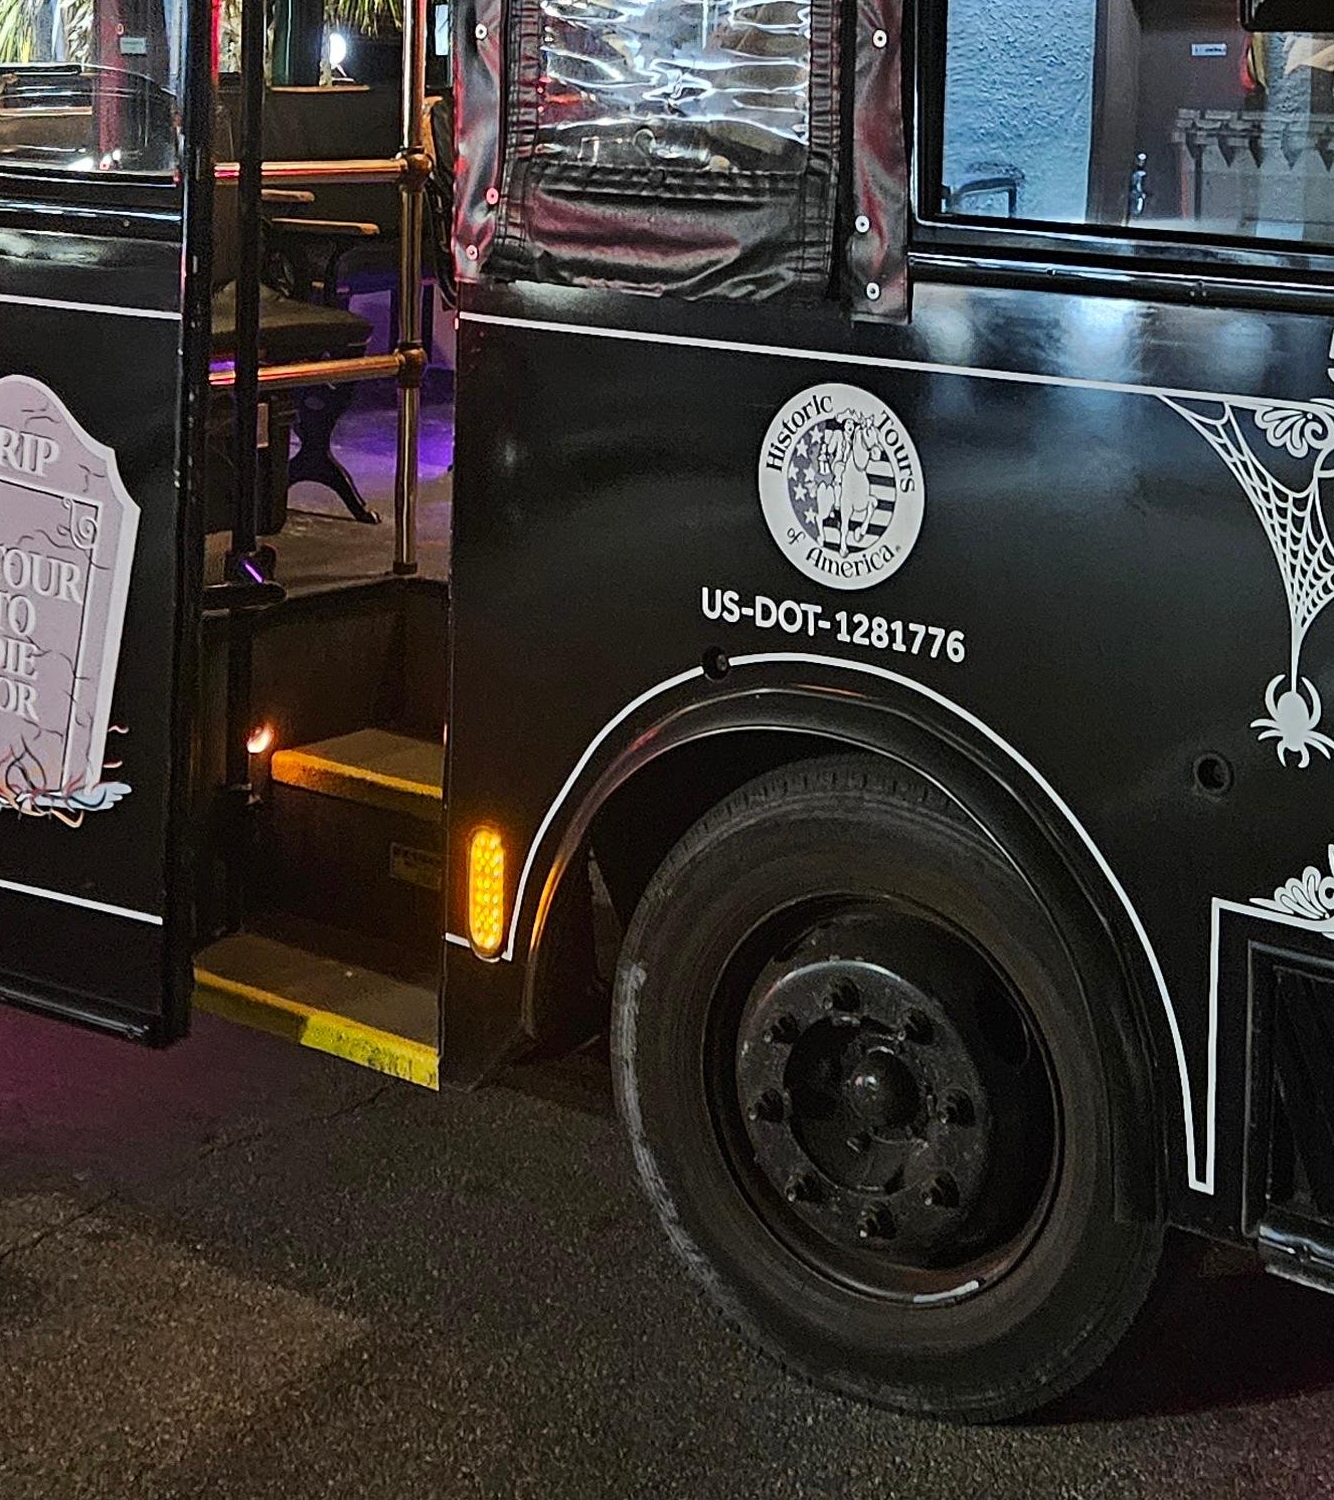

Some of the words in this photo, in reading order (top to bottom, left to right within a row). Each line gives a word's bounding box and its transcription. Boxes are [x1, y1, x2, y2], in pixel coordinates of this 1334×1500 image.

[766, 394, 834, 473] Historic
[875, 409, 916, 494] Tours
[786, 526, 806, 546] of
[805, 543, 895, 580] America
[701, 586, 966, 663] US-DOT-1281776
